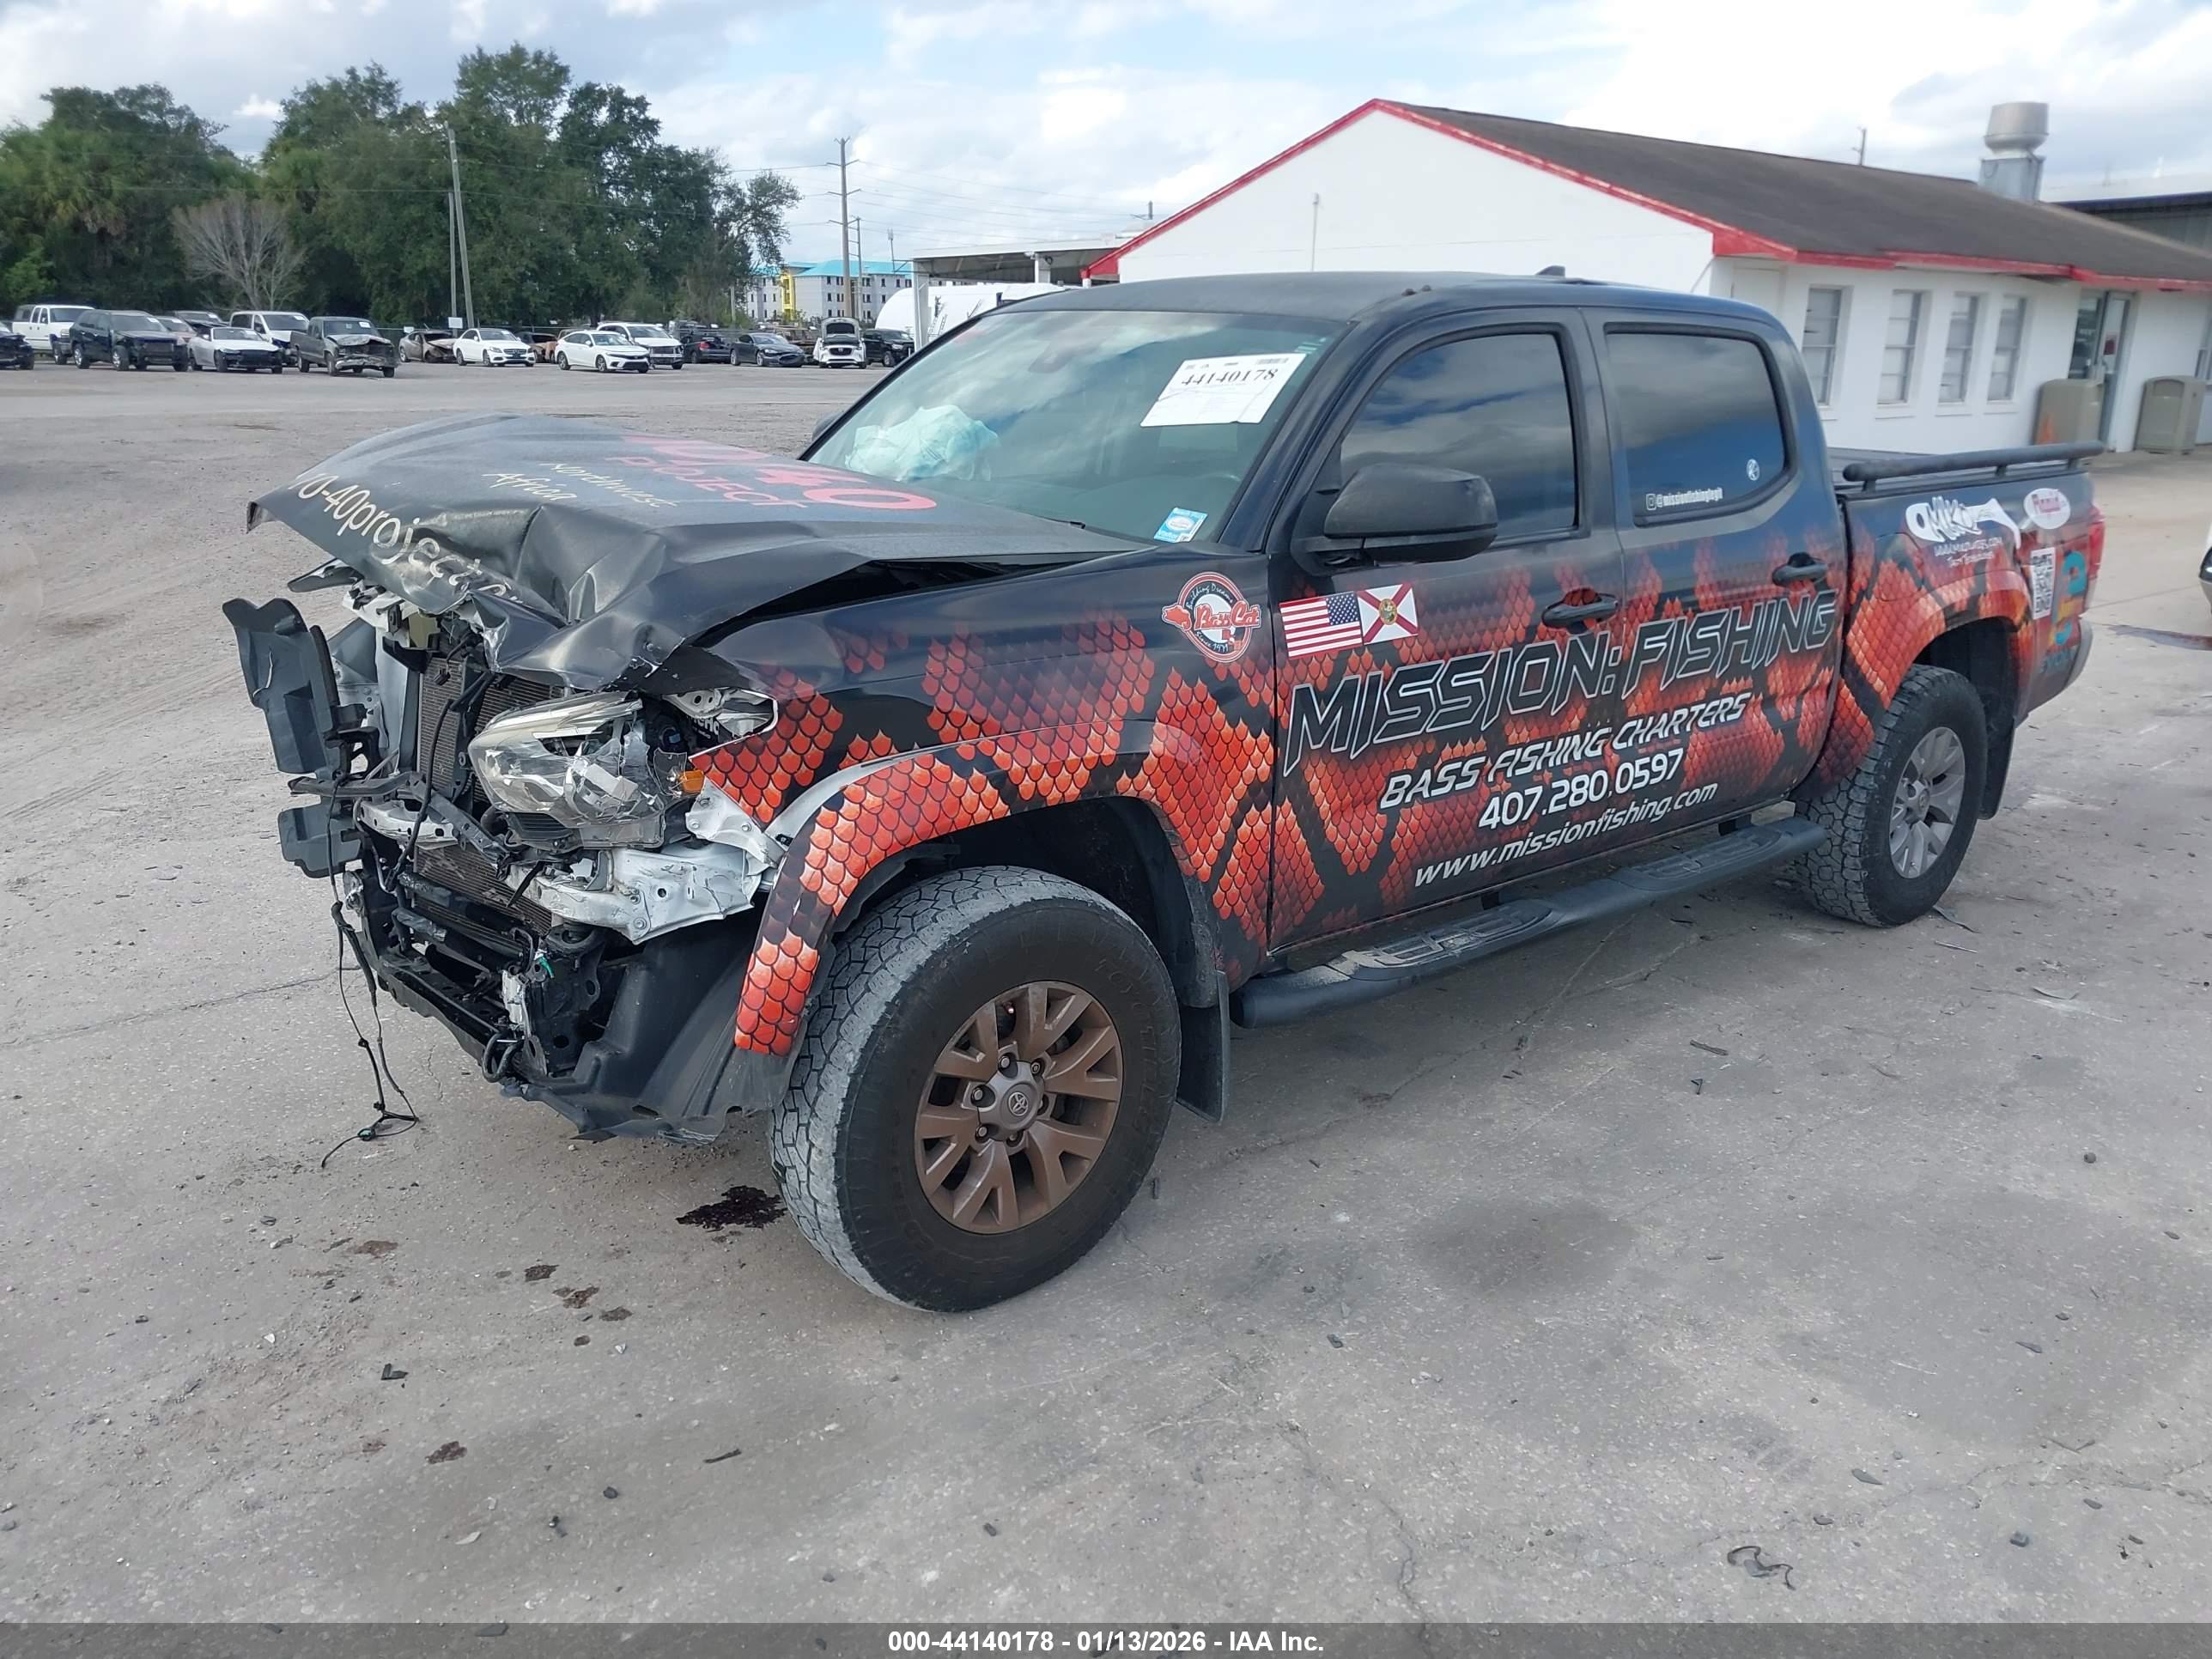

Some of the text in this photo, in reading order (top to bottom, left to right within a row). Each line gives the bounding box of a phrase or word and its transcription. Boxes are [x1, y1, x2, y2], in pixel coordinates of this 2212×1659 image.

[1182, 368, 1279, 386] 44140178
[481, 473, 577, 501] Africa
[605, 455, 808, 508] POJECT
[1186, 582, 1233, 610] Building Dreams
[1283, 588, 1839, 777] MISSION: FISHING
[1380, 692, 1753, 809] BASS FISHING CHARTERS
[1479, 748, 1684, 830] 407.280.0597
[1414, 782, 1718, 888] www.missionfishing.com
